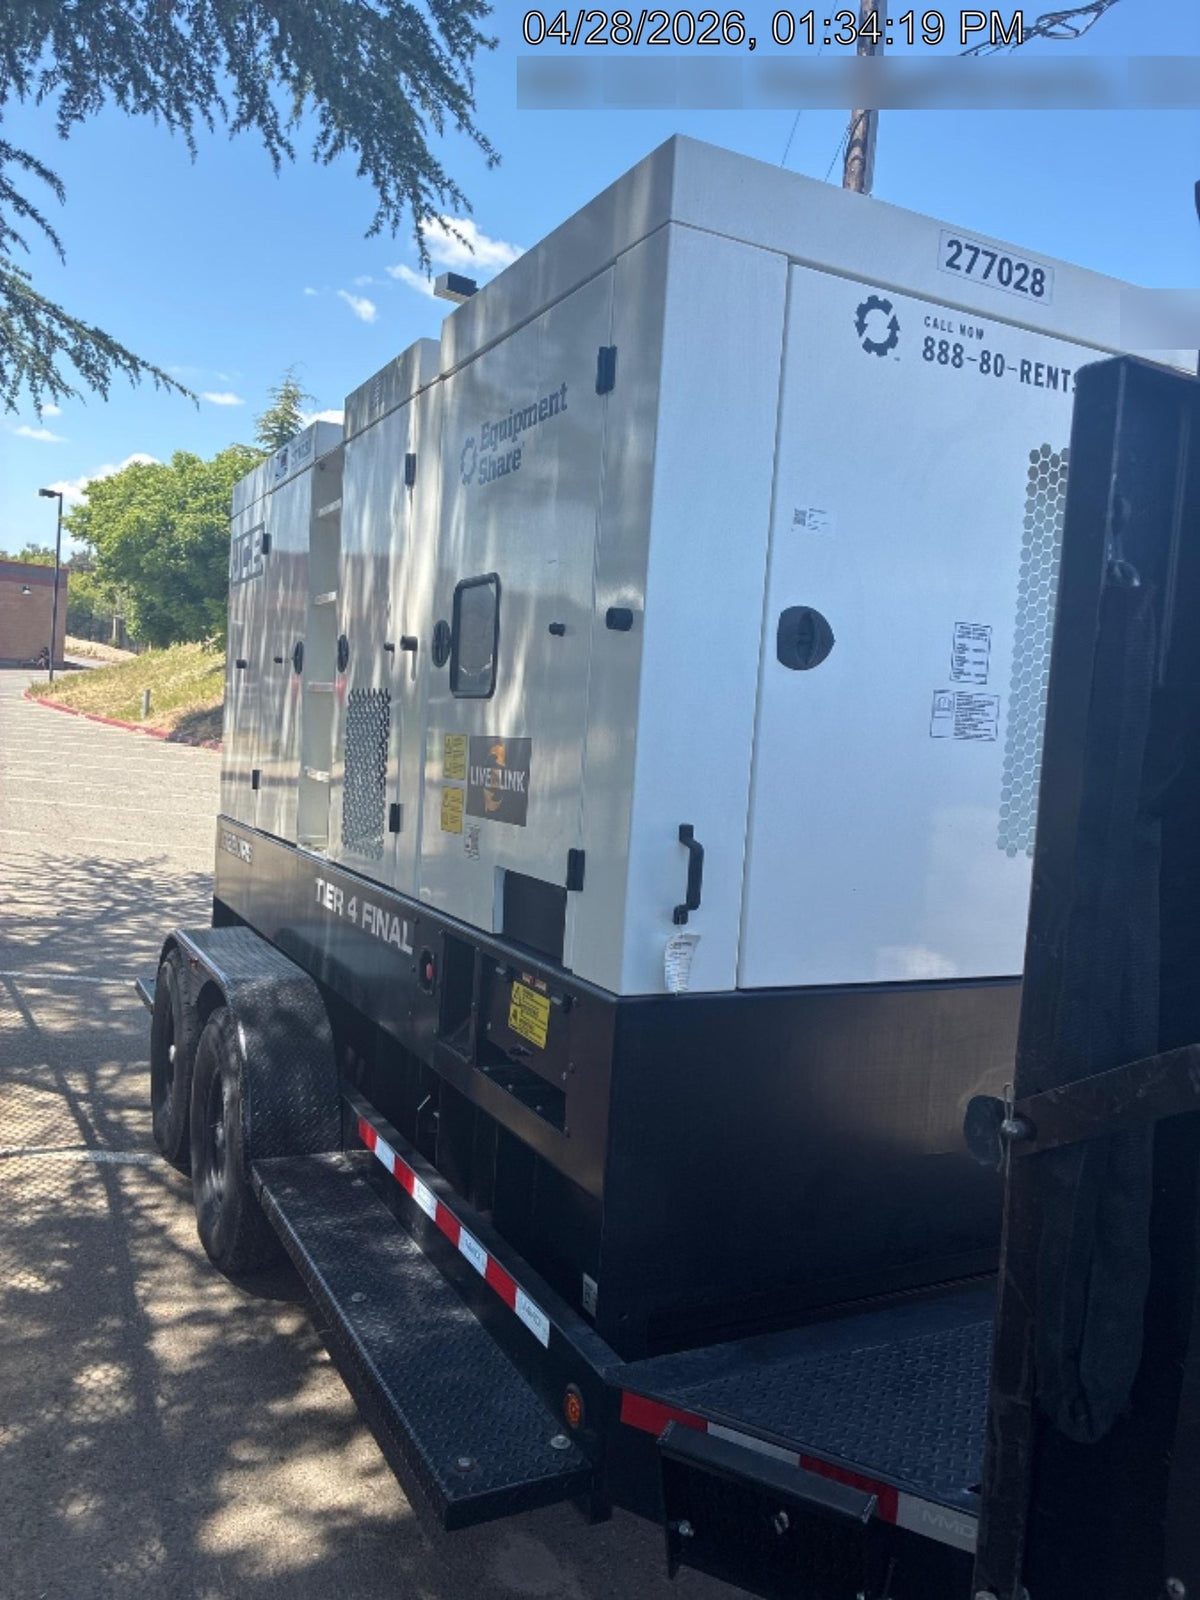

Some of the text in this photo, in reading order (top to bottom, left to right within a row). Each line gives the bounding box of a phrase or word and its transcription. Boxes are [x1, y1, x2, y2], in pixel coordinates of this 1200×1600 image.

[945, 239, 1046, 298] 277028
[924, 315, 985, 340] CALL NOW
[922, 336, 1076, 393] 888-80-RENT
[480, 382, 568, 452] Equipment
[478, 448, 522, 486] Share
[499, 767, 526, 792] LINK
[314, 877, 414, 956] TIER 4 FINAL
